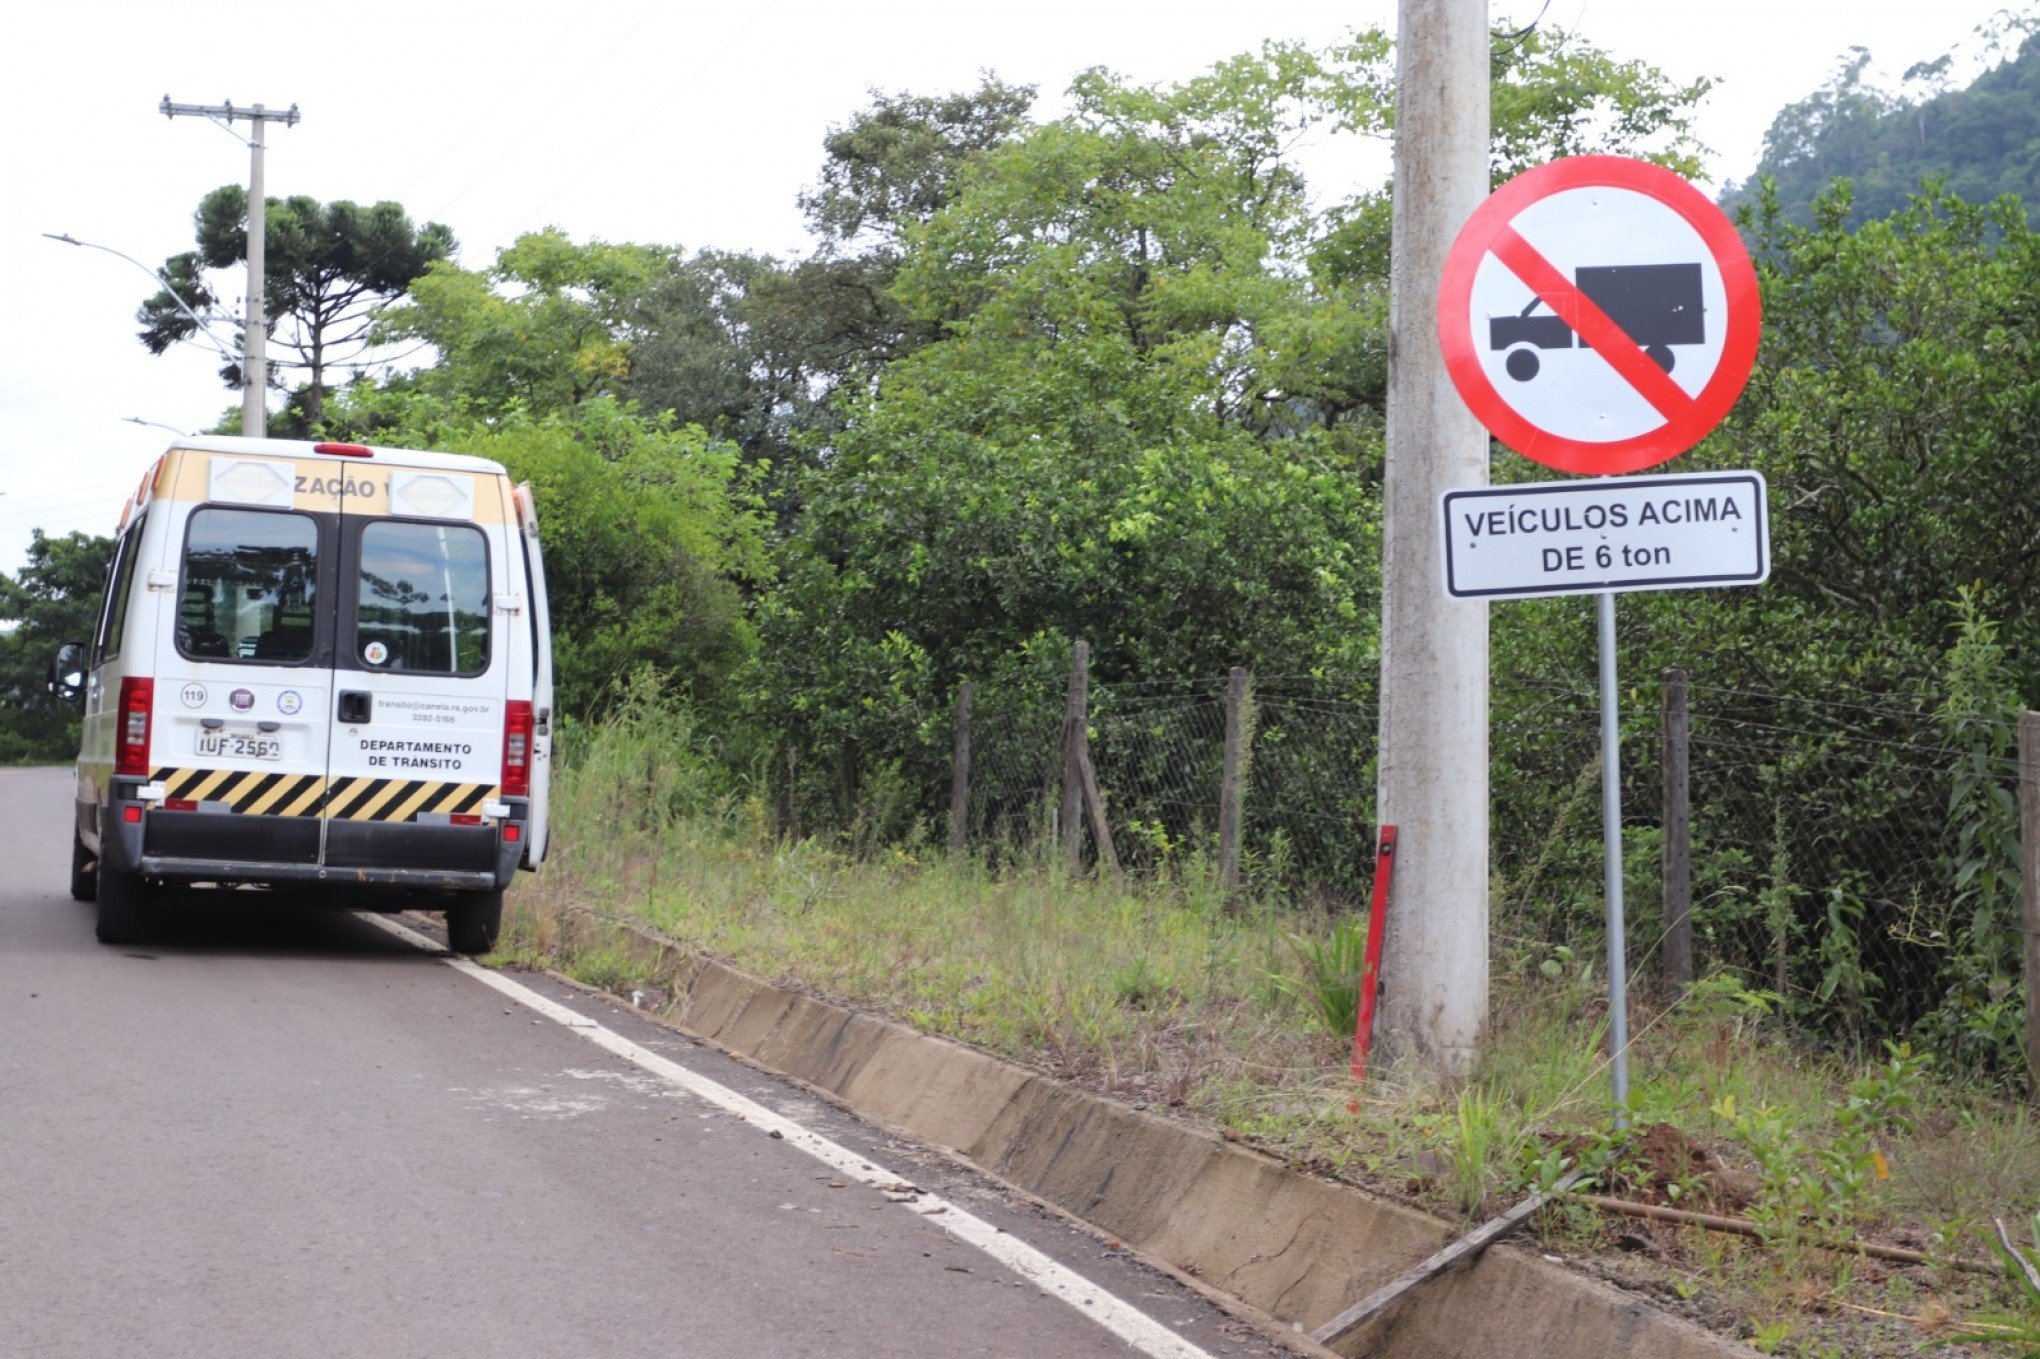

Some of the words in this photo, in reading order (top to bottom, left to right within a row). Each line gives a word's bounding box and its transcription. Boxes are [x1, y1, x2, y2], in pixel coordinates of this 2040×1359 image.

[1464, 502, 1628, 537] VEÍCULOS
[1638, 496, 1742, 526] ACIMA
[1542, 546, 1585, 572] DE
[1595, 544, 1612, 569] 6
[1622, 546, 1671, 568] ton
[184, 690, 204, 701] 119
[360, 739, 472, 755] DEPARTAMENTO
[368, 756, 387, 767] DE
